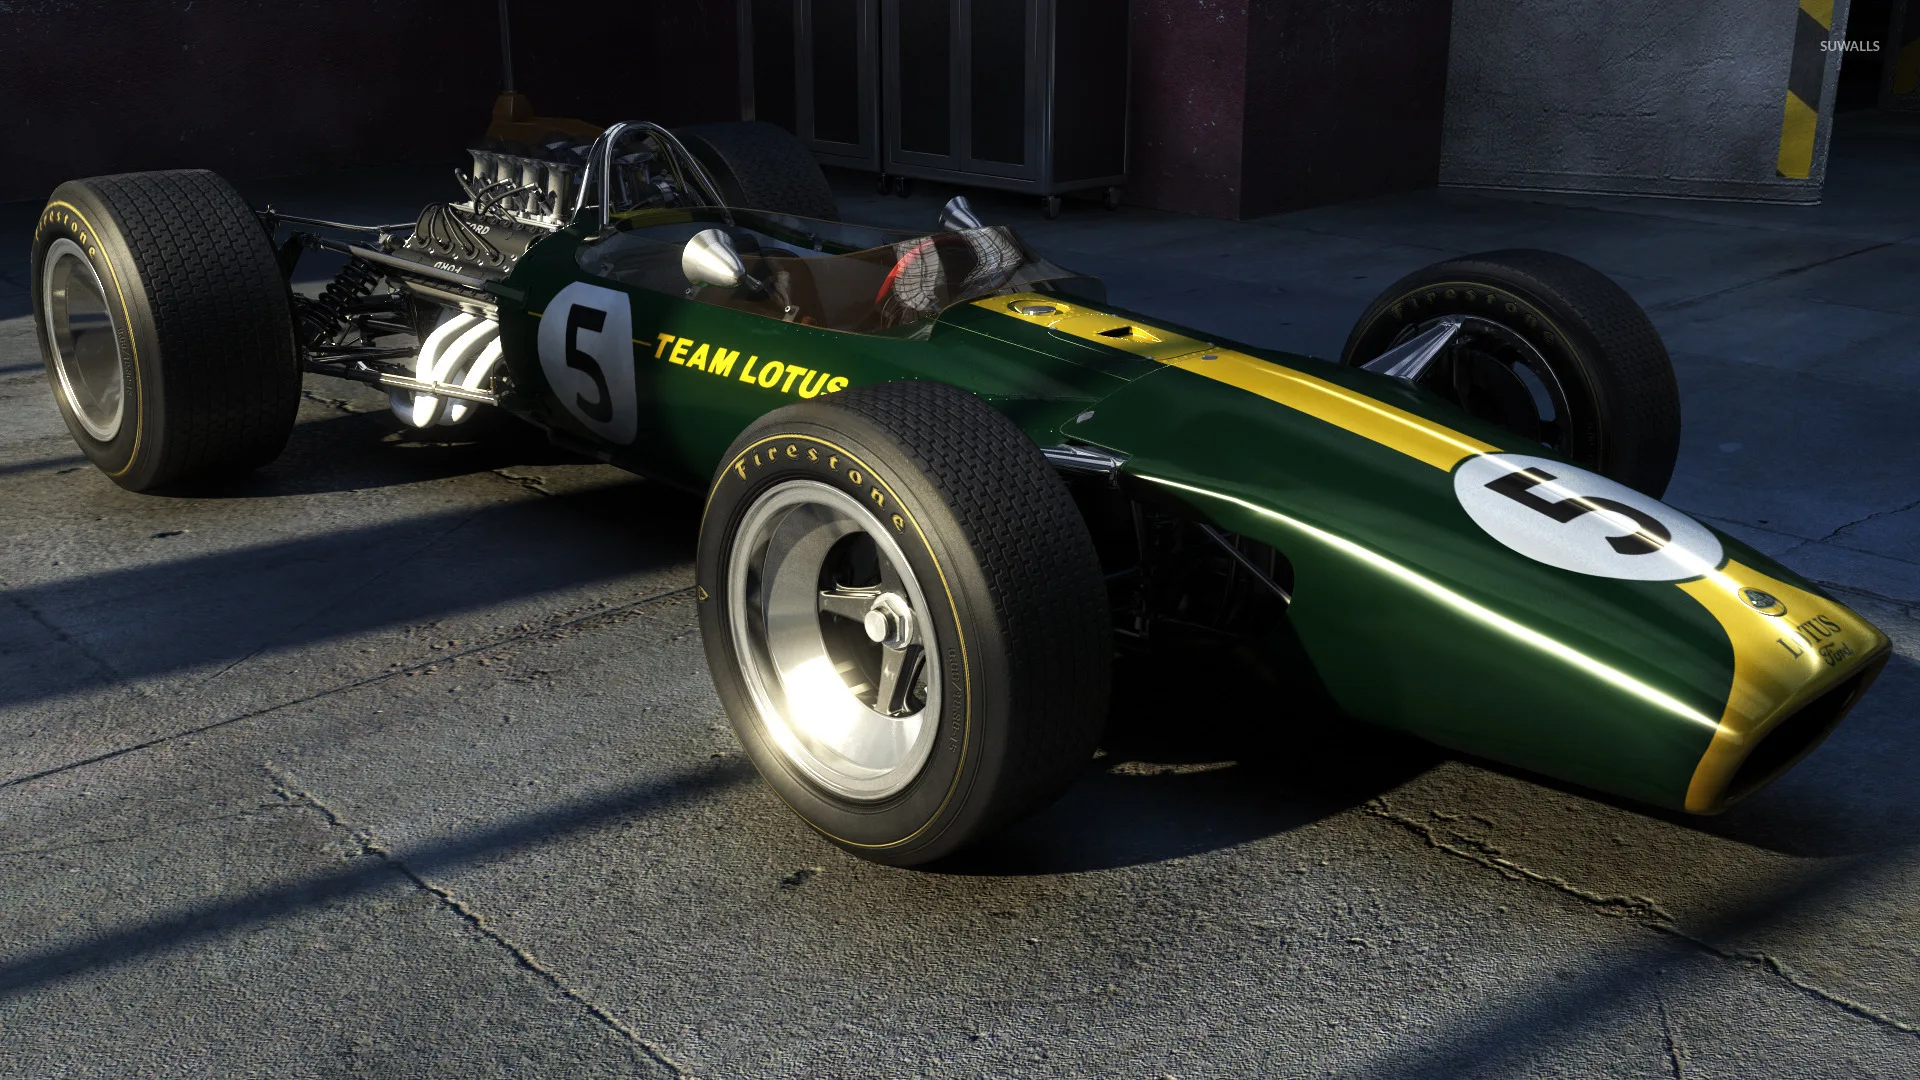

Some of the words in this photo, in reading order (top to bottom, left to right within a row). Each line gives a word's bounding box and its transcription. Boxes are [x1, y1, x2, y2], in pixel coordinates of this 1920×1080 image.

[565, 303, 613, 424] 5
[654, 332, 741, 379] TEAM
[739, 354, 849, 400] LOTUS
[734, 443, 906, 534] Firestone
[1483, 466, 1672, 556] 5
[1776, 614, 1842, 660] LOTUS
